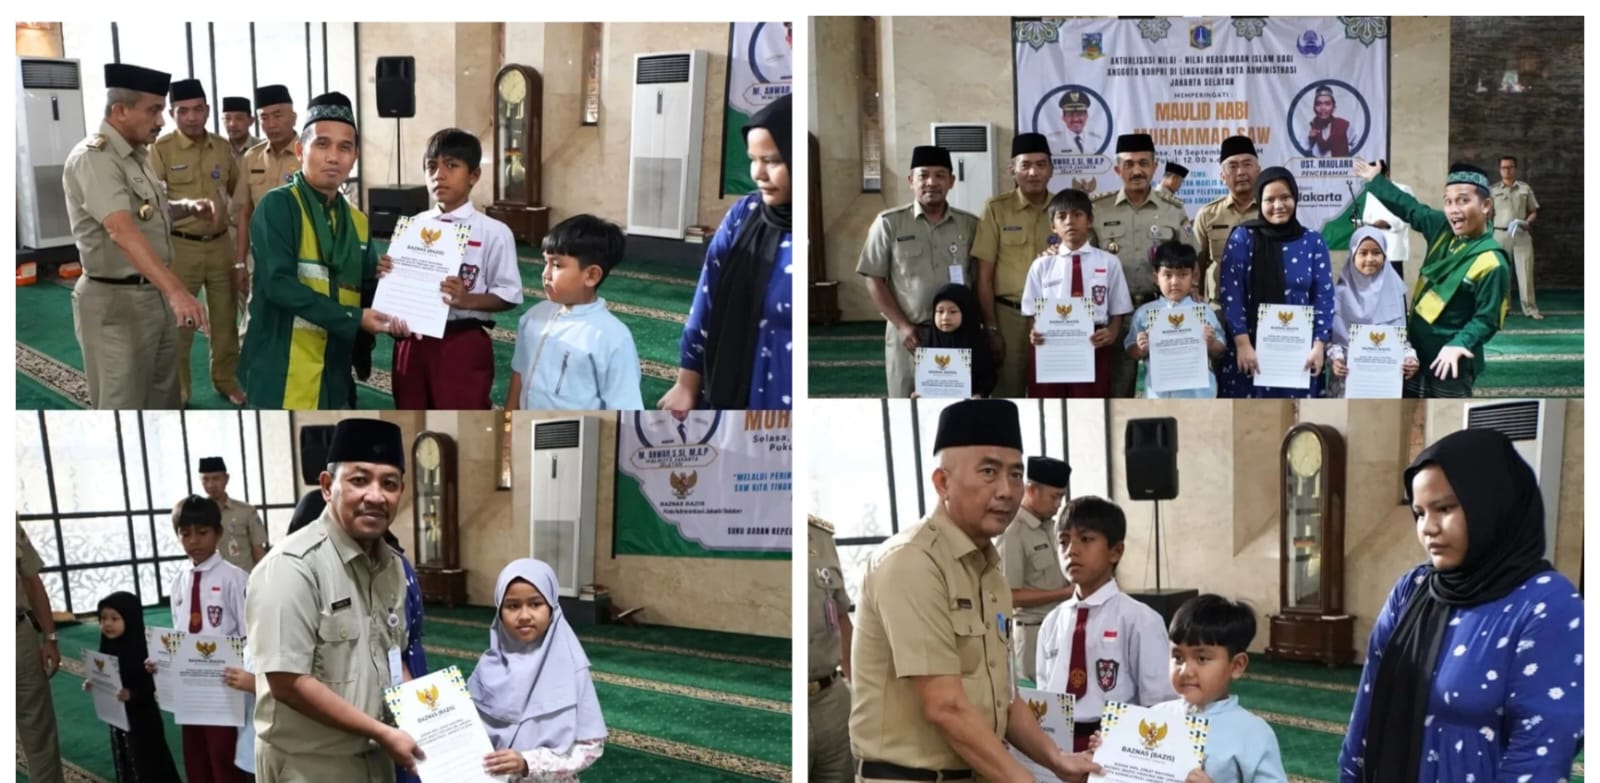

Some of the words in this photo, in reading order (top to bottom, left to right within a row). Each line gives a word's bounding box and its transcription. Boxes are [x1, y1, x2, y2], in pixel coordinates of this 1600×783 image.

[1158, 56, 1177, 65] NILAI
[1184, 55, 1204, 64] NILAI
[1206, 55, 1249, 64] KEAGAMAAN
[1251, 55, 1274, 63] ISLAM
[1277, 55, 1293, 63] BAGI
[1107, 67, 1139, 76] ANGGOTA
[1170, 66, 1177, 75] DI
[1180, 66, 1223, 75] LINGKUNGAN
[1226, 66, 1243, 75] KOTA
[1246, 65, 1297, 74] ADMINISTRASI
[1170, 78, 1201, 87] JAKARTA
[1204, 78, 1234, 86] SELATAN
[1155, 102, 1211, 121] MAULID
[1214, 101, 1249, 120] NABI
[1300, 159, 1317, 169] UST.
[1318, 159, 1354, 169] MAULANA
[1298, 191, 1342, 202] Jakarta
[752, 433, 790, 444] Selasa,
[1121, 746, 1149, 757] BAZNAS
[1150, 752, 1175, 762] (BAZIS)
